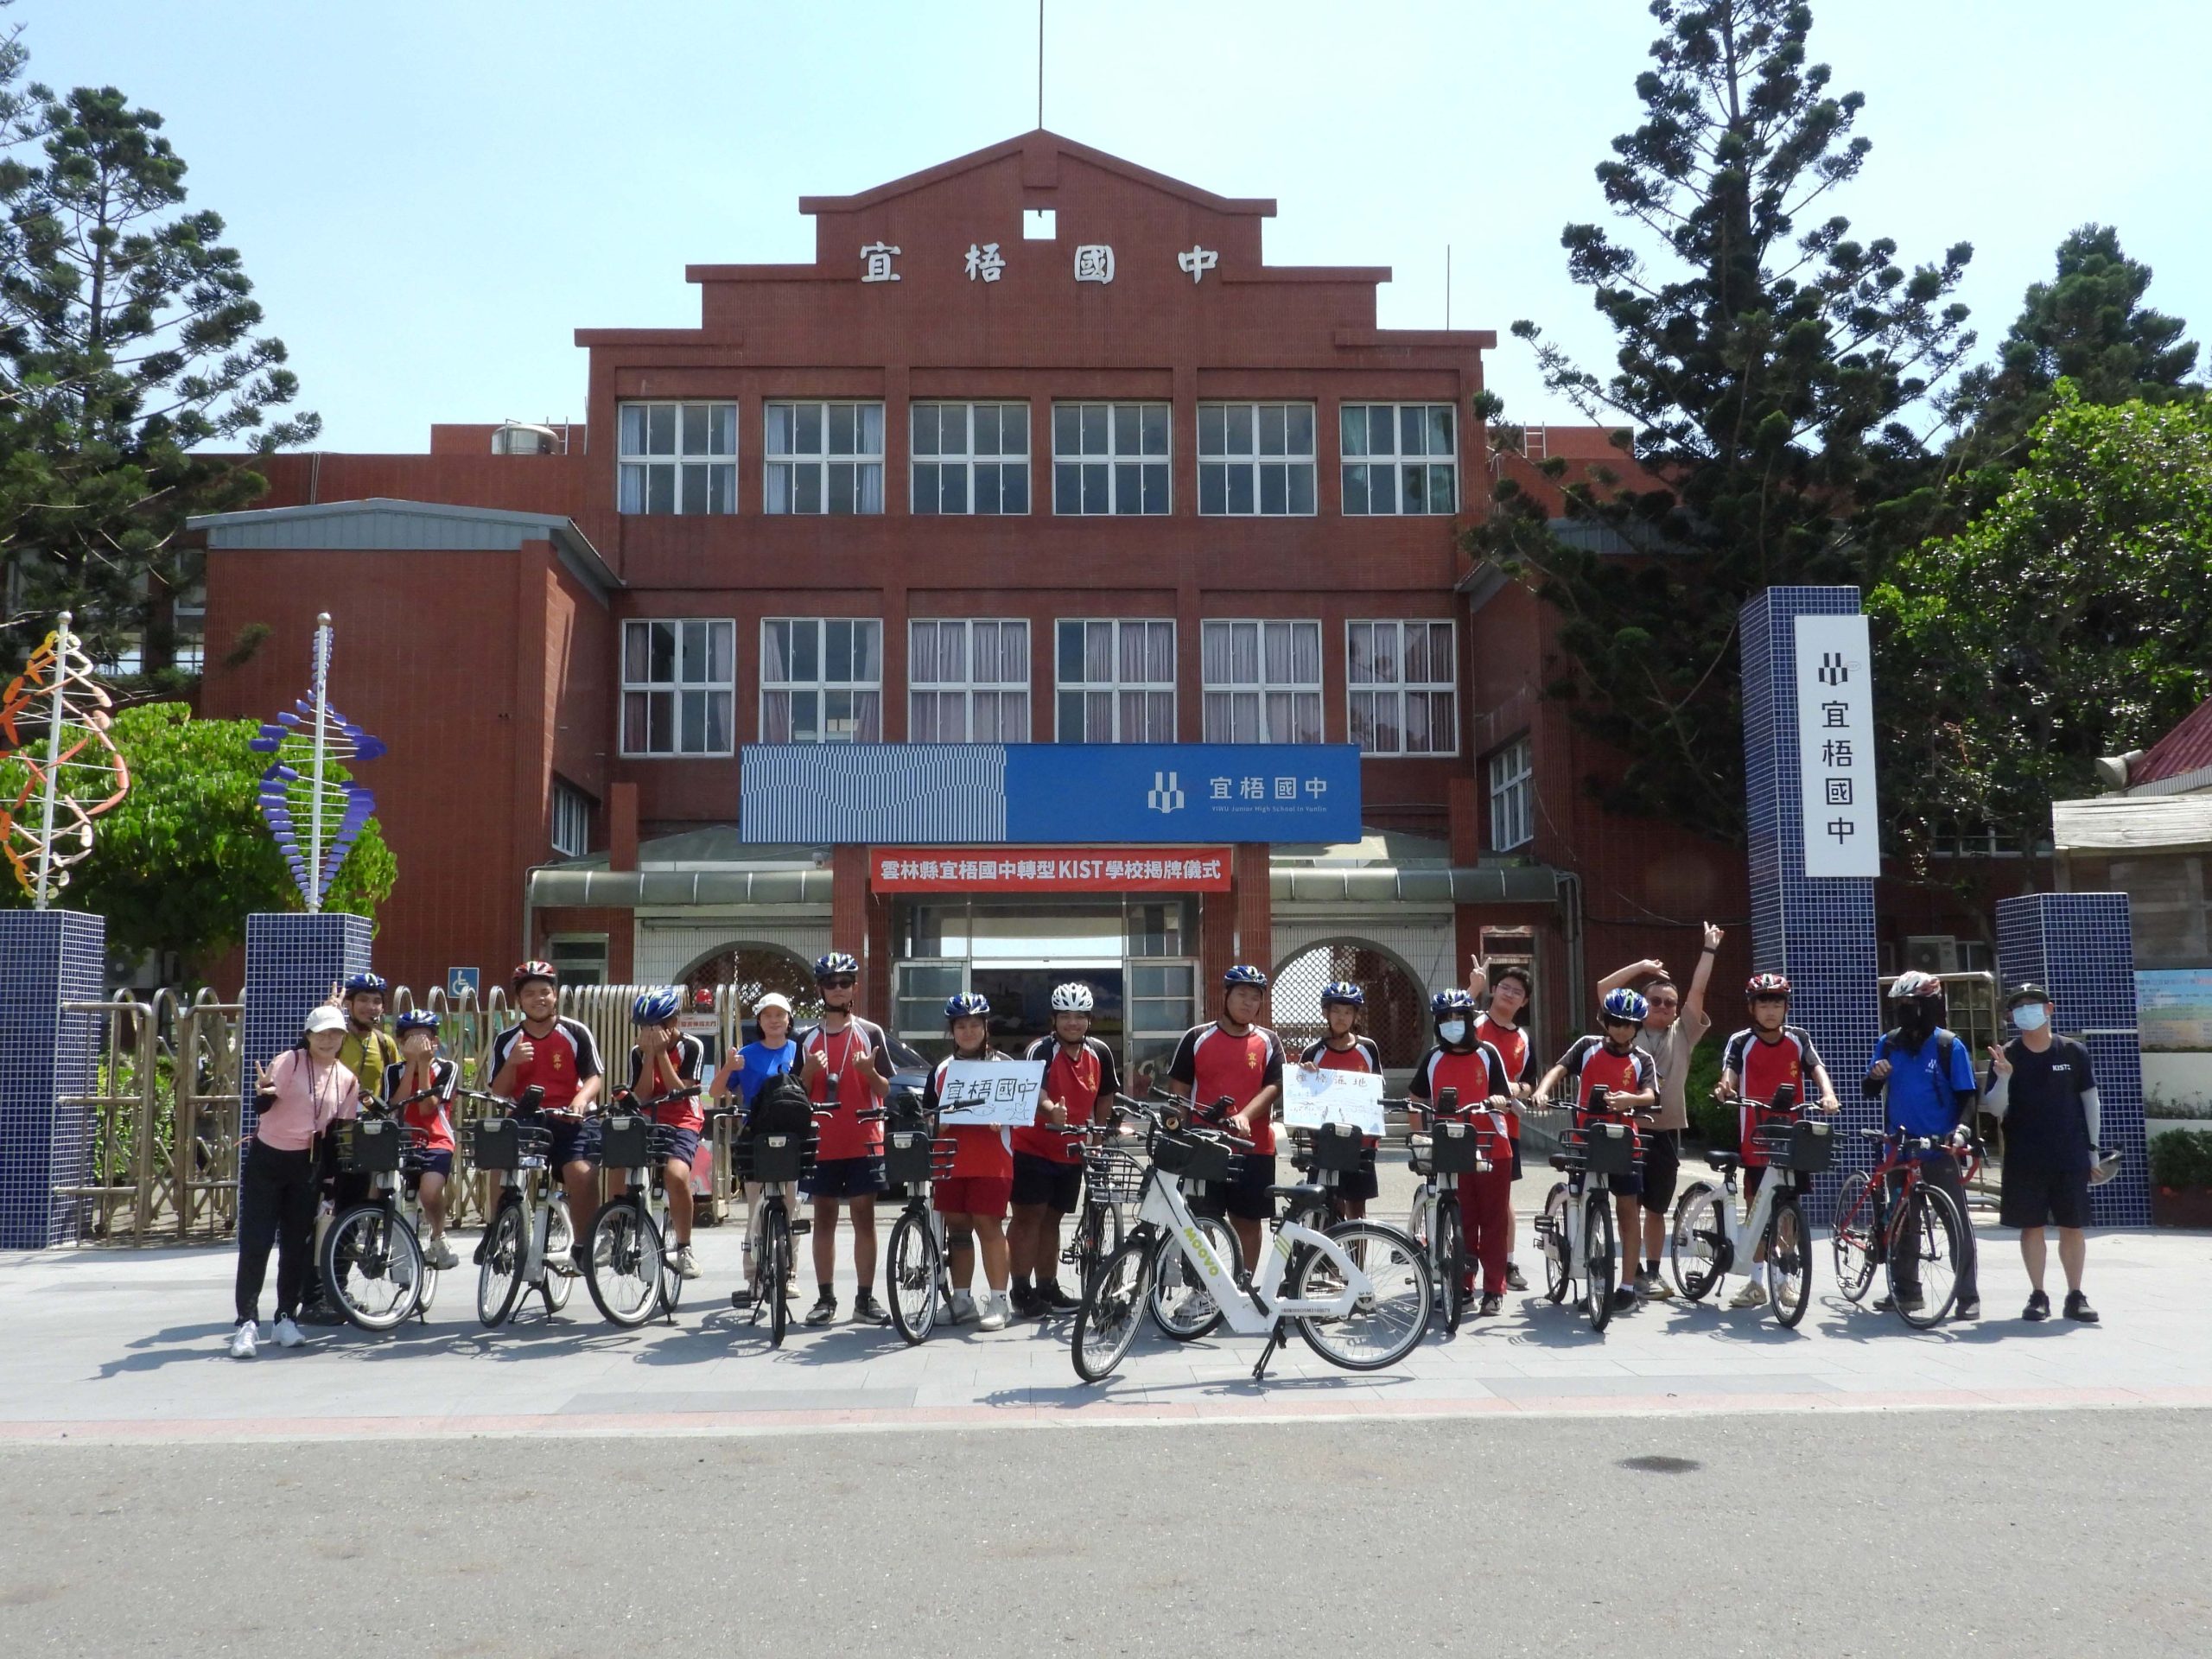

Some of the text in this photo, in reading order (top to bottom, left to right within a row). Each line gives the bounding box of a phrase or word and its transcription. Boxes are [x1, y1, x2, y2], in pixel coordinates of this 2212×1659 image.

[860, 241, 1219, 284] 宜梧國中
[1210, 777, 1327, 799] 宜梧國中
[1821, 700, 1854, 844] 宜梧國中
[1184, 1227, 1219, 1276] MOOVO
